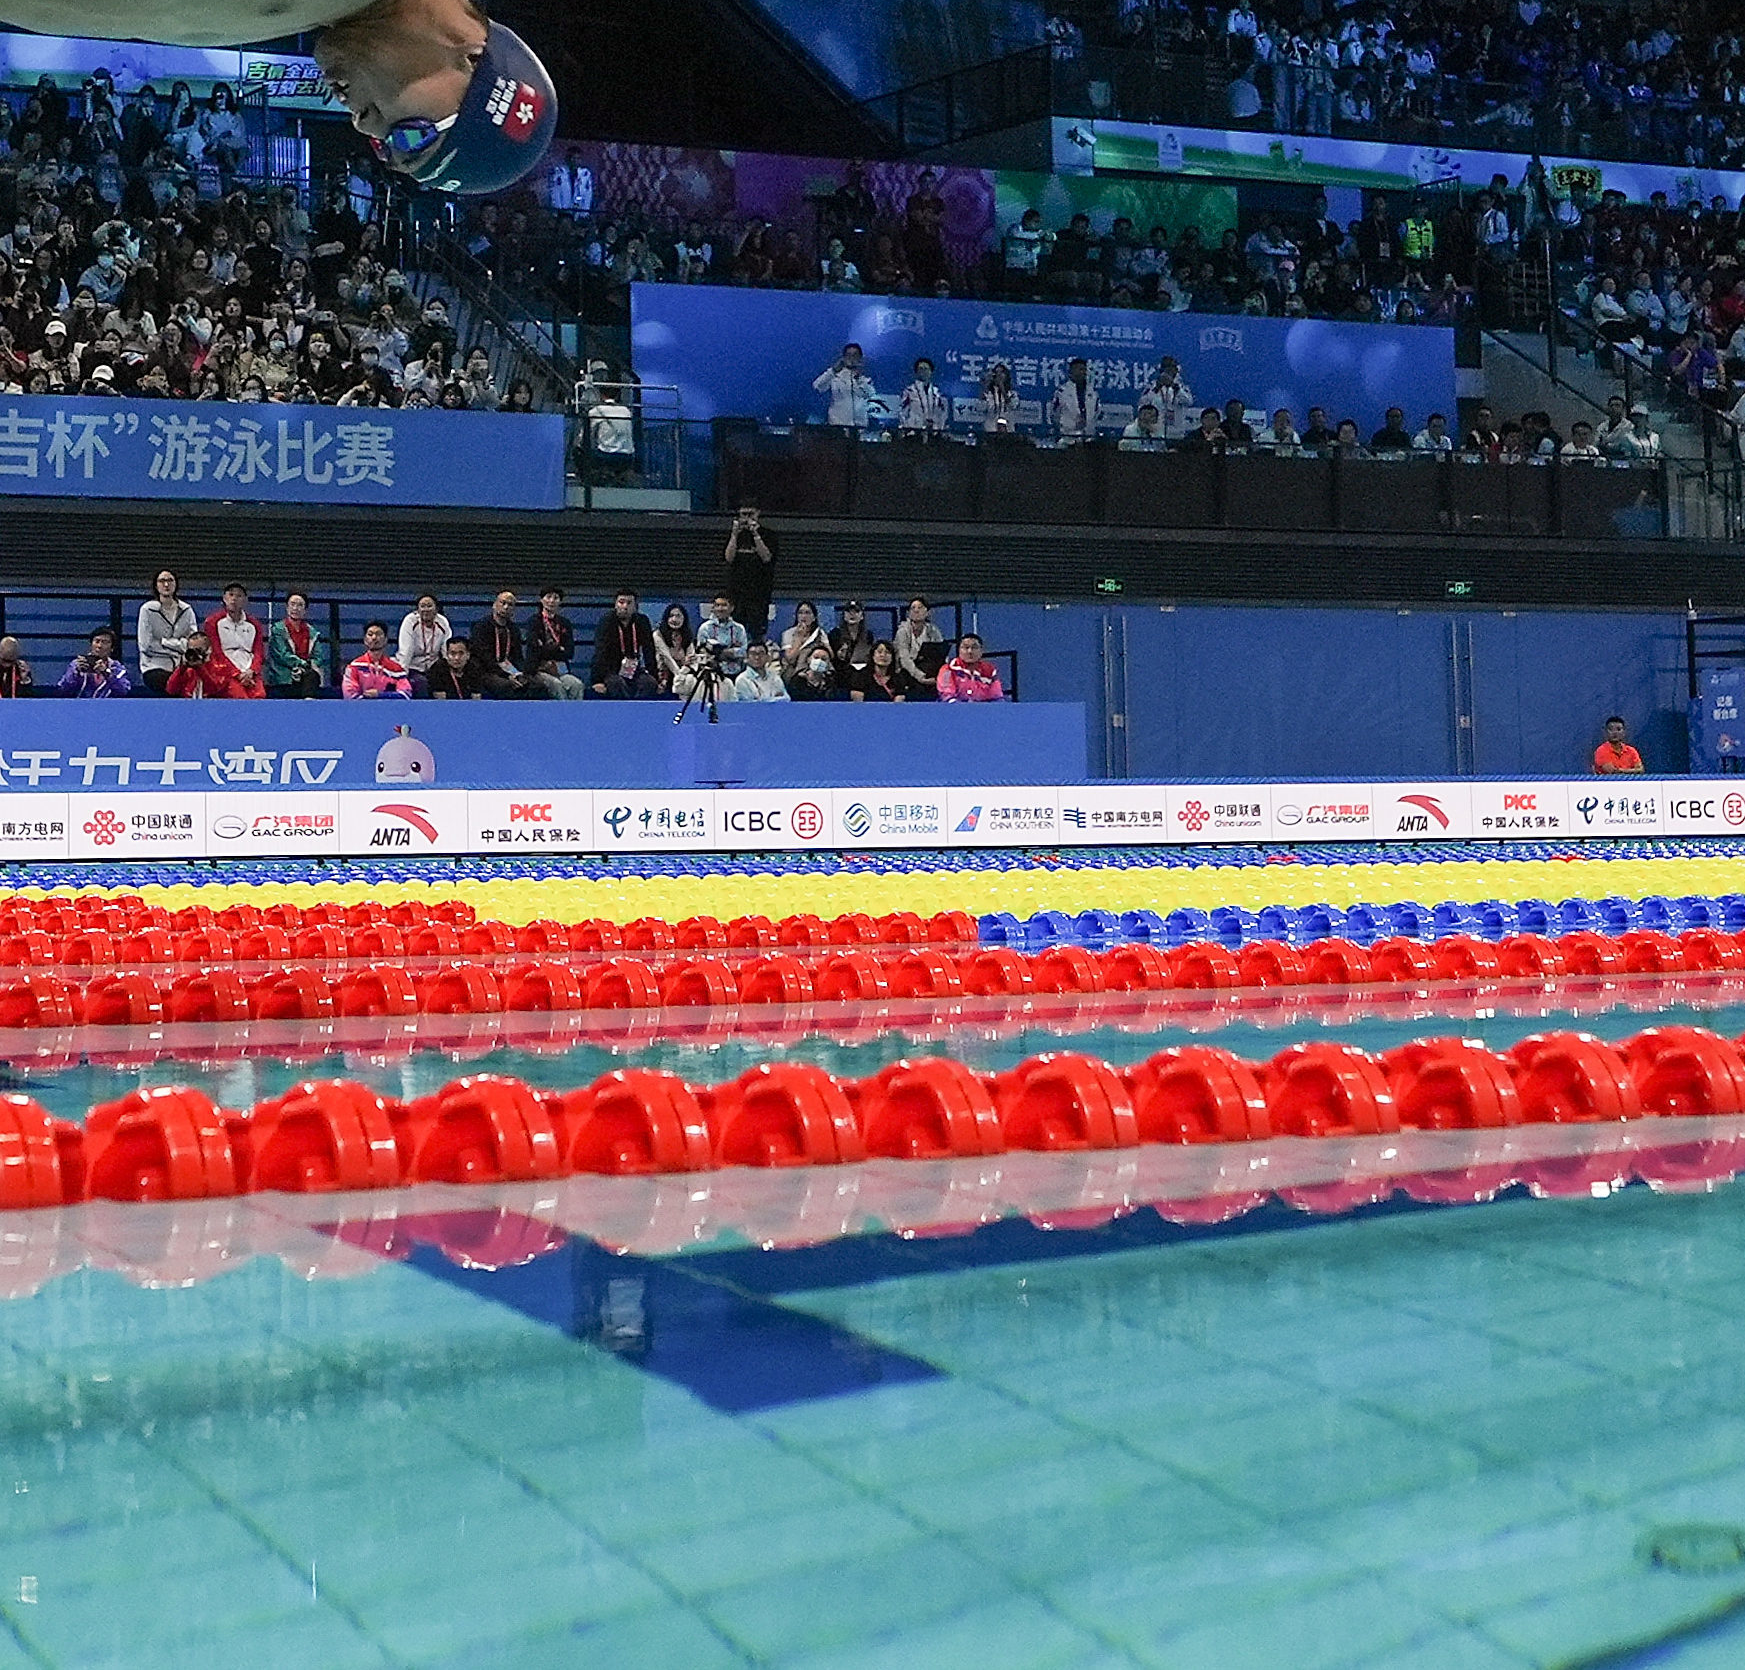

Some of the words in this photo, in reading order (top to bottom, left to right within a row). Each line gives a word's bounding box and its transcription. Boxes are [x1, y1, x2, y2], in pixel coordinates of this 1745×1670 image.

[1504, 794, 1536, 810] PICC
[1670, 800, 1715, 818] ICBC
[510, 804, 552, 822] PICC
[879, 805, 938, 820] 中国移动
[990, 808, 1054, 822] 中国南方航空
[1091, 811, 1162, 823] 中国南方电网
[1214, 804, 1260, 817] 中国联通
[1307, 805, 1369, 816] 广汽集团
[132, 814, 192, 829] 中国联通
[252, 815, 333, 828] 广汽集团
[638, 807, 704, 830] 中国电信
[724, 811, 781, 832] ICBC
[1397, 816, 1429, 832] ANTA
[1482, 816, 1559, 828] 中国人民保险
[283, 828, 334, 836] GROUP
[369, 828, 410, 846] ANTA
[481, 829, 580, 843] 中国人民保险
